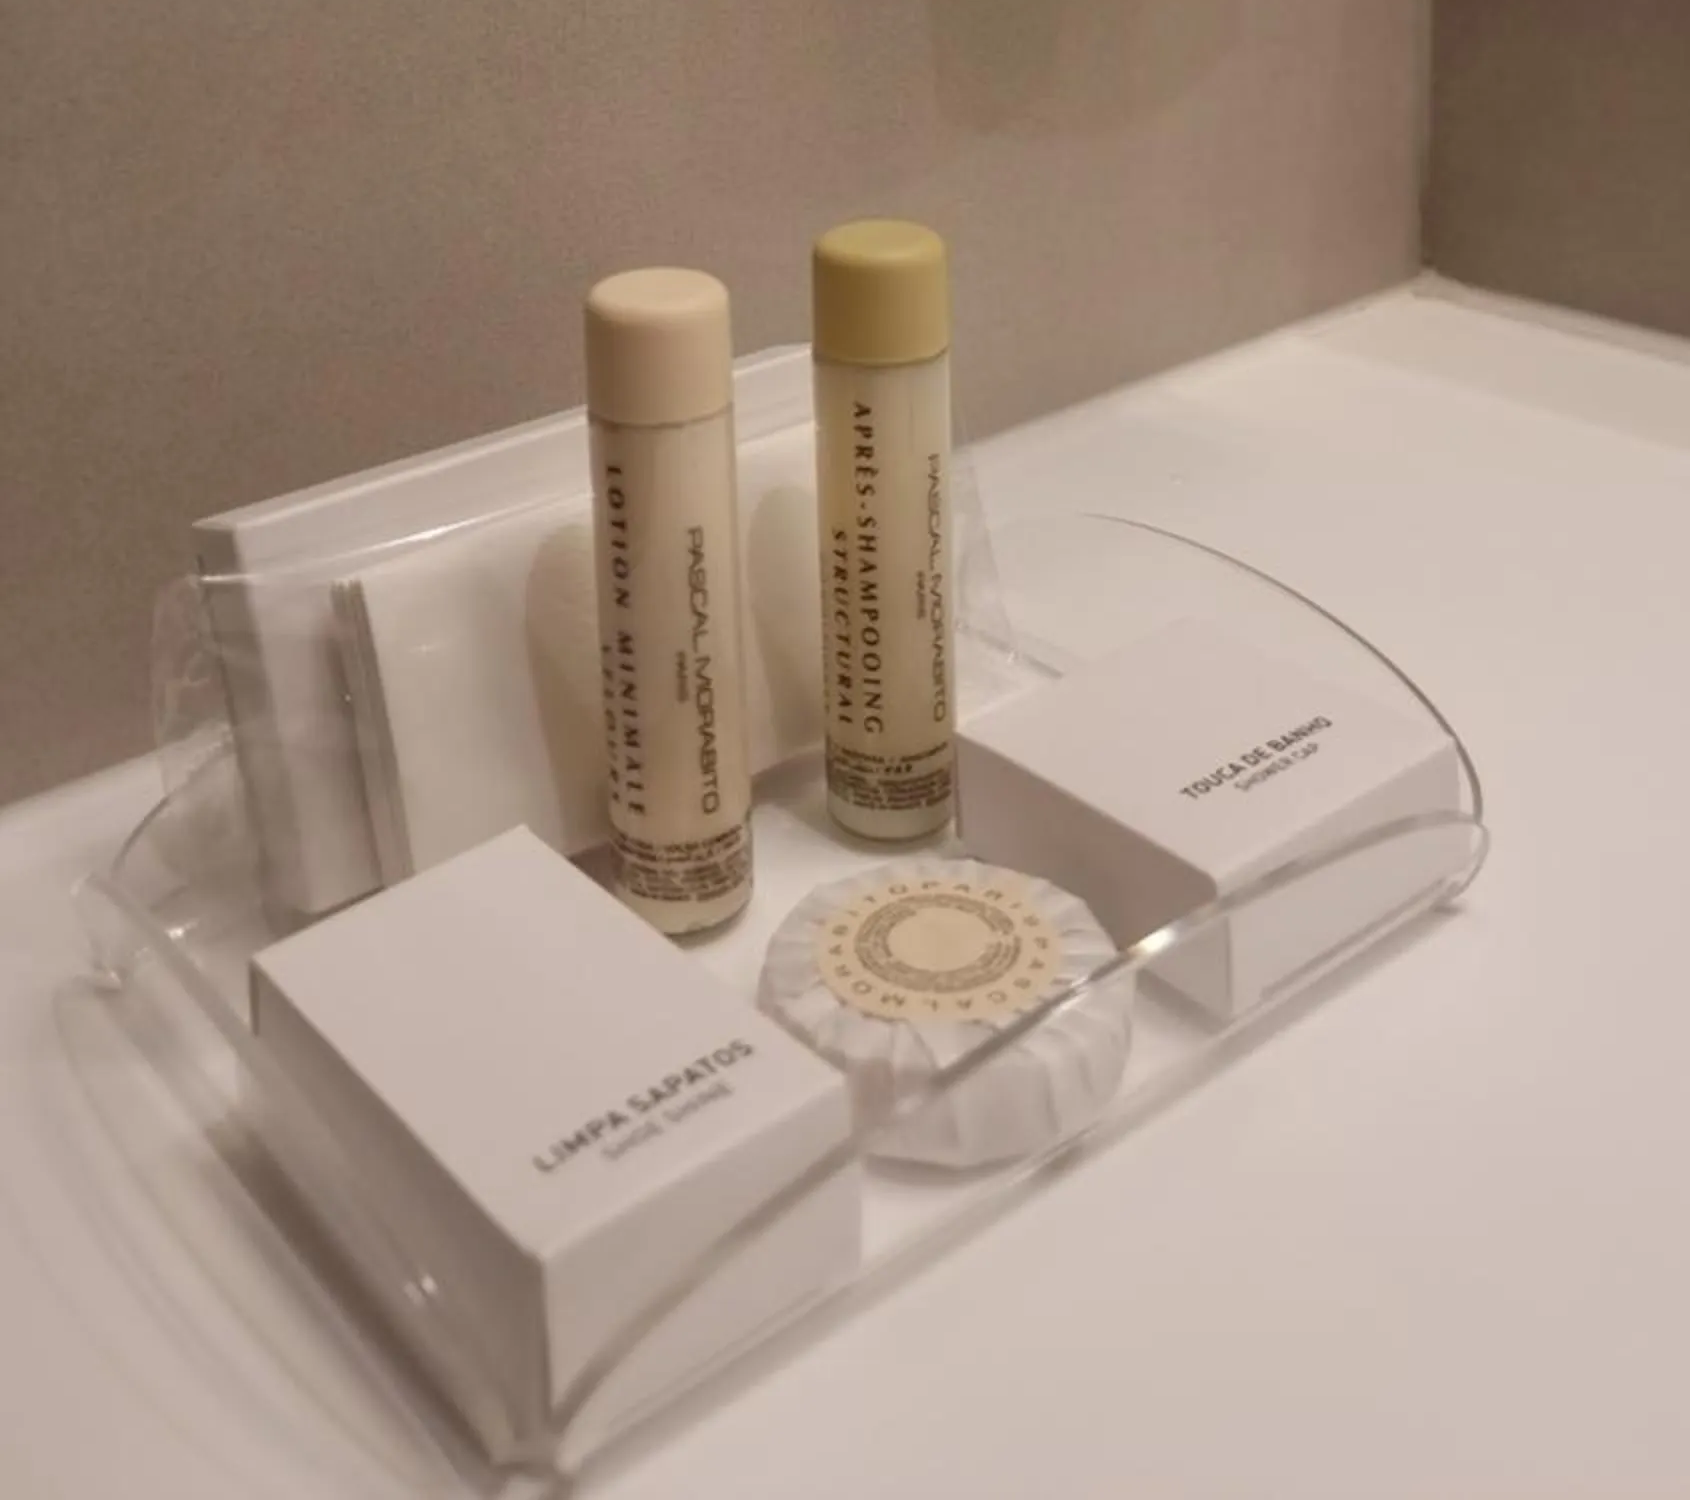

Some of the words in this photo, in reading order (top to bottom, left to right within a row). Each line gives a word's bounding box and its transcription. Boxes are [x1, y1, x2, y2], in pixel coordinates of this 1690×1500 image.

[607, 464, 630, 610] LOTION
[926, 453, 944, 573] PASCAL
[687, 526, 709, 653] PASCAL
[929, 573, 948, 723] MORABITO
[617, 630, 646, 818] MINIMALE
[695, 654, 721, 816] MORABITO
[1179, 762, 1247, 801] TOUCA
[1240, 747, 1273, 766] DE
[531, 1109, 630, 1173] LIMPA
[625, 1038, 755, 1113] SAPATOS
